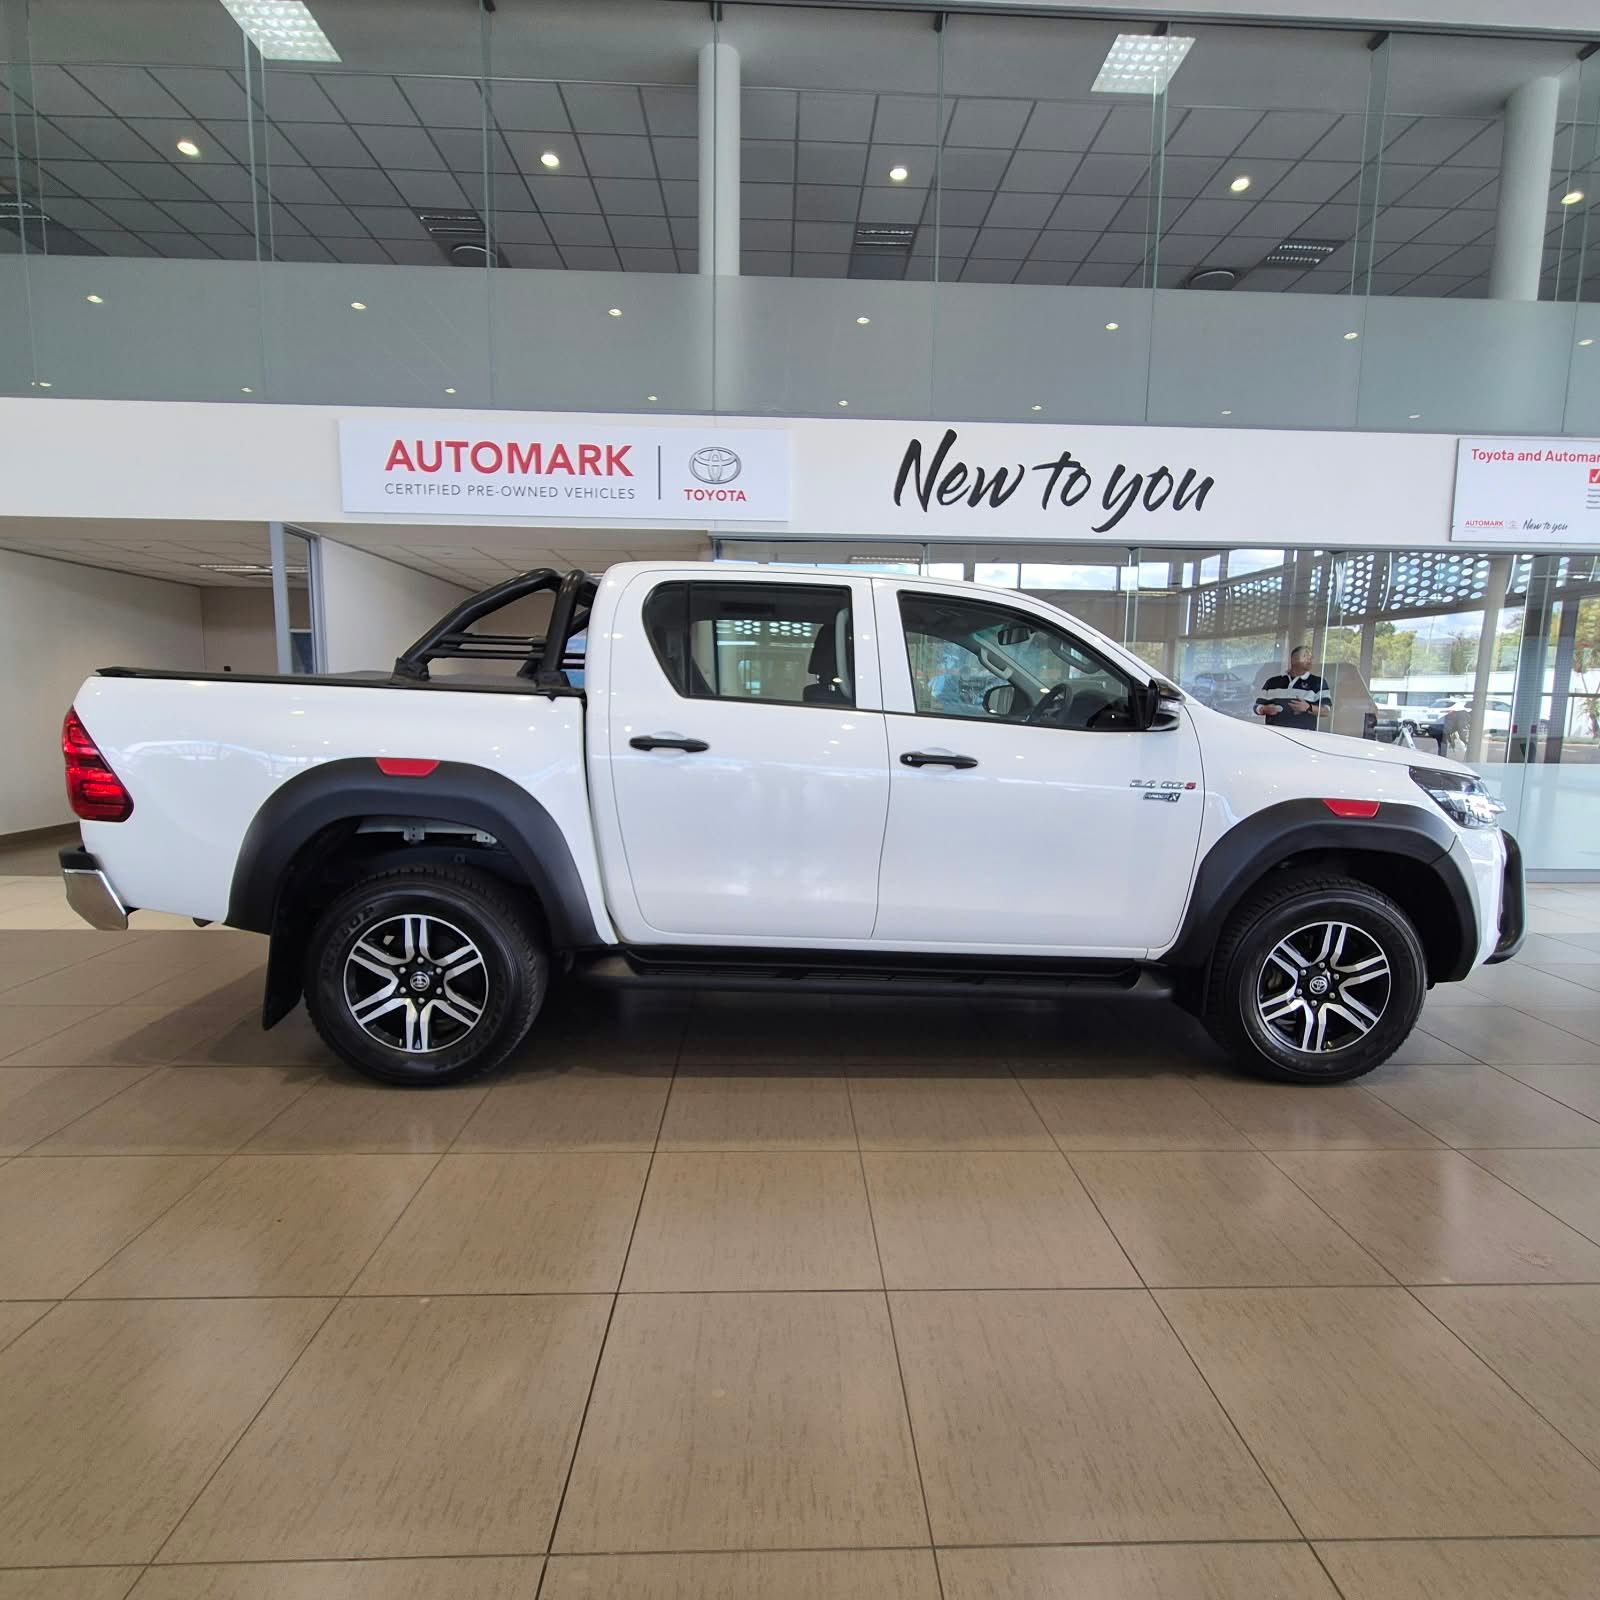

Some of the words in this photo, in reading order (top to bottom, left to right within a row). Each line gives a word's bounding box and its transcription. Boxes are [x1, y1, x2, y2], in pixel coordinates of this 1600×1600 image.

[384, 439, 634, 478] AUTOMARK
[1472, 448, 1514, 464] Toyota
[1518, 450, 1542, 461] and
[893, 428, 1025, 512] New
[1031, 451, 1092, 510] to
[1091, 464, 1215, 534] you
[384, 482, 461, 497] CERTIFIED
[467, 484, 559, 499] PRE-OWNED
[564, 486, 635, 500] VEHICLES
[684, 488, 747, 502] TOYOTA
[1522, 518, 1543, 530] New
[1543, 521, 1551, 530] to
[1551, 523, 1568, 533] you
